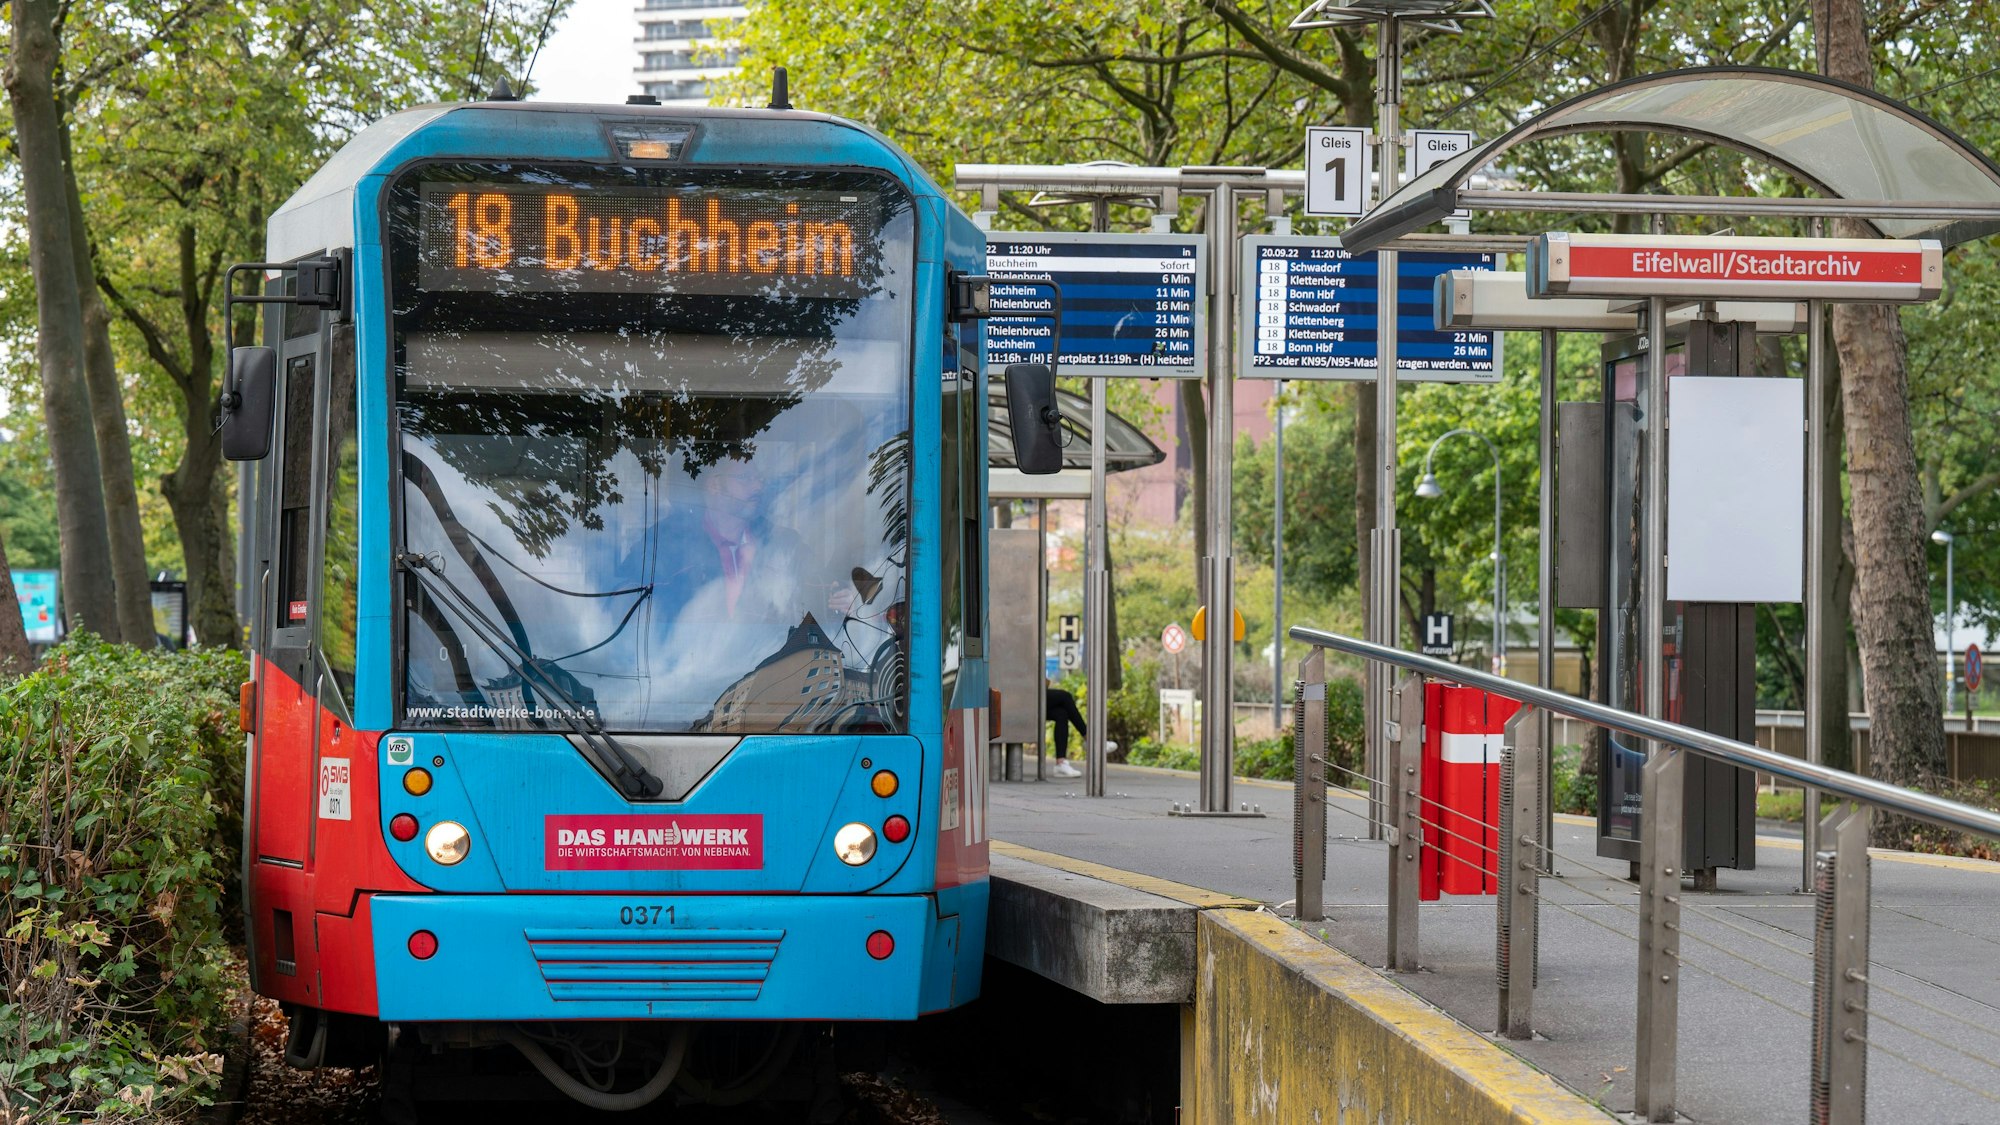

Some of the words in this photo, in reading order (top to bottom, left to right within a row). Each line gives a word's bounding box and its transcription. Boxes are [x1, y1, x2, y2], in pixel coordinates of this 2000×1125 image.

[1321, 137, 1351, 148] Gleis
[1428, 140, 1458, 151] Gleis
[1326, 158, 1345, 201] 1
[448, 193, 511, 268] 18
[546, 194, 853, 276] Buchheim
[1009, 246, 1033, 254] 11:20
[1035, 246, 1051, 254] Uhr
[1262, 248, 1298, 257] 20.09.22
[1311, 250, 1334, 258] 11:20
[1336, 250, 1352, 258] Uhr
[1482, 254, 1490, 262] in
[989, 259, 1038, 268] Buchheim
[1160, 261, 1190, 270] Sofort
[1290, 262, 1341, 272] Schwadorf
[1632, 252, 1860, 278] Eifelwall/Stadtarchiv
[1162, 274, 1169, 284] 6
[1171, 274, 1190, 284] Min
[1290, 276, 1346, 288] Klettenberg
[990, 286, 1036, 295] Buchheim
[1156, 288, 1168, 298] 11
[1170, 288, 1190, 298] Min
[1290, 289, 1314, 298] Bonn
[1317, 290, 1335, 299] Hbf
[990, 299, 1050, 308] Thielenbruch
[1156, 301, 1168, 310] 16
[1170, 302, 1190, 310] Min
[1289, 302, 1340, 312] Schwadorf
[1156, 314, 1168, 324] 21
[1170, 314, 1189, 324] Min
[1289, 316, 1344, 328] Klettenberg
[988, 326, 1050, 336] Thielenbruch
[1155, 328, 1168, 338] 26
[1170, 328, 1188, 338] Min
[1288, 329, 1344, 341] Klettenberg
[1454, 333, 1466, 342] 22
[1469, 333, 1488, 343] Min
[988, 339, 1035, 348] Buchheim
[1170, 342, 1188, 350] Min
[1288, 342, 1312, 352] Bonn
[1316, 343, 1334, 352] Hbf
[1454, 346, 1466, 356] 26
[1468, 346, 1487, 356] Min
[988, 353, 1021, 362] 11:16h
[1030, 354, 1044, 364] (H)
[1047, 354, 1096, 365] Eertplatz
[1098, 354, 1132, 364] 11:19h
[1140, 355, 1155, 365] (H)
[1276, 356, 1298, 366] oder
[1396, 359, 1428, 370] tragen
[1431, 360, 1470, 369] werden.
[1472, 362, 1492, 370] ww
[1060, 617, 1078, 640] H
[1427, 616, 1448, 644] H
[1064, 646, 1074, 666] 5
[330, 766, 348, 784] SWB
[558, 829, 606, 845] DAS
[614, 821, 748, 845] HANDWERK
[558, 848, 572, 857] DIE
[576, 848, 680, 857] WIRTSCHAFTSMACHT.
[682, 848, 700, 857] VON
[704, 848, 750, 856] NEBENAN.
[620, 906, 676, 924] 0371
[646, 1002, 652, 1014] 1
